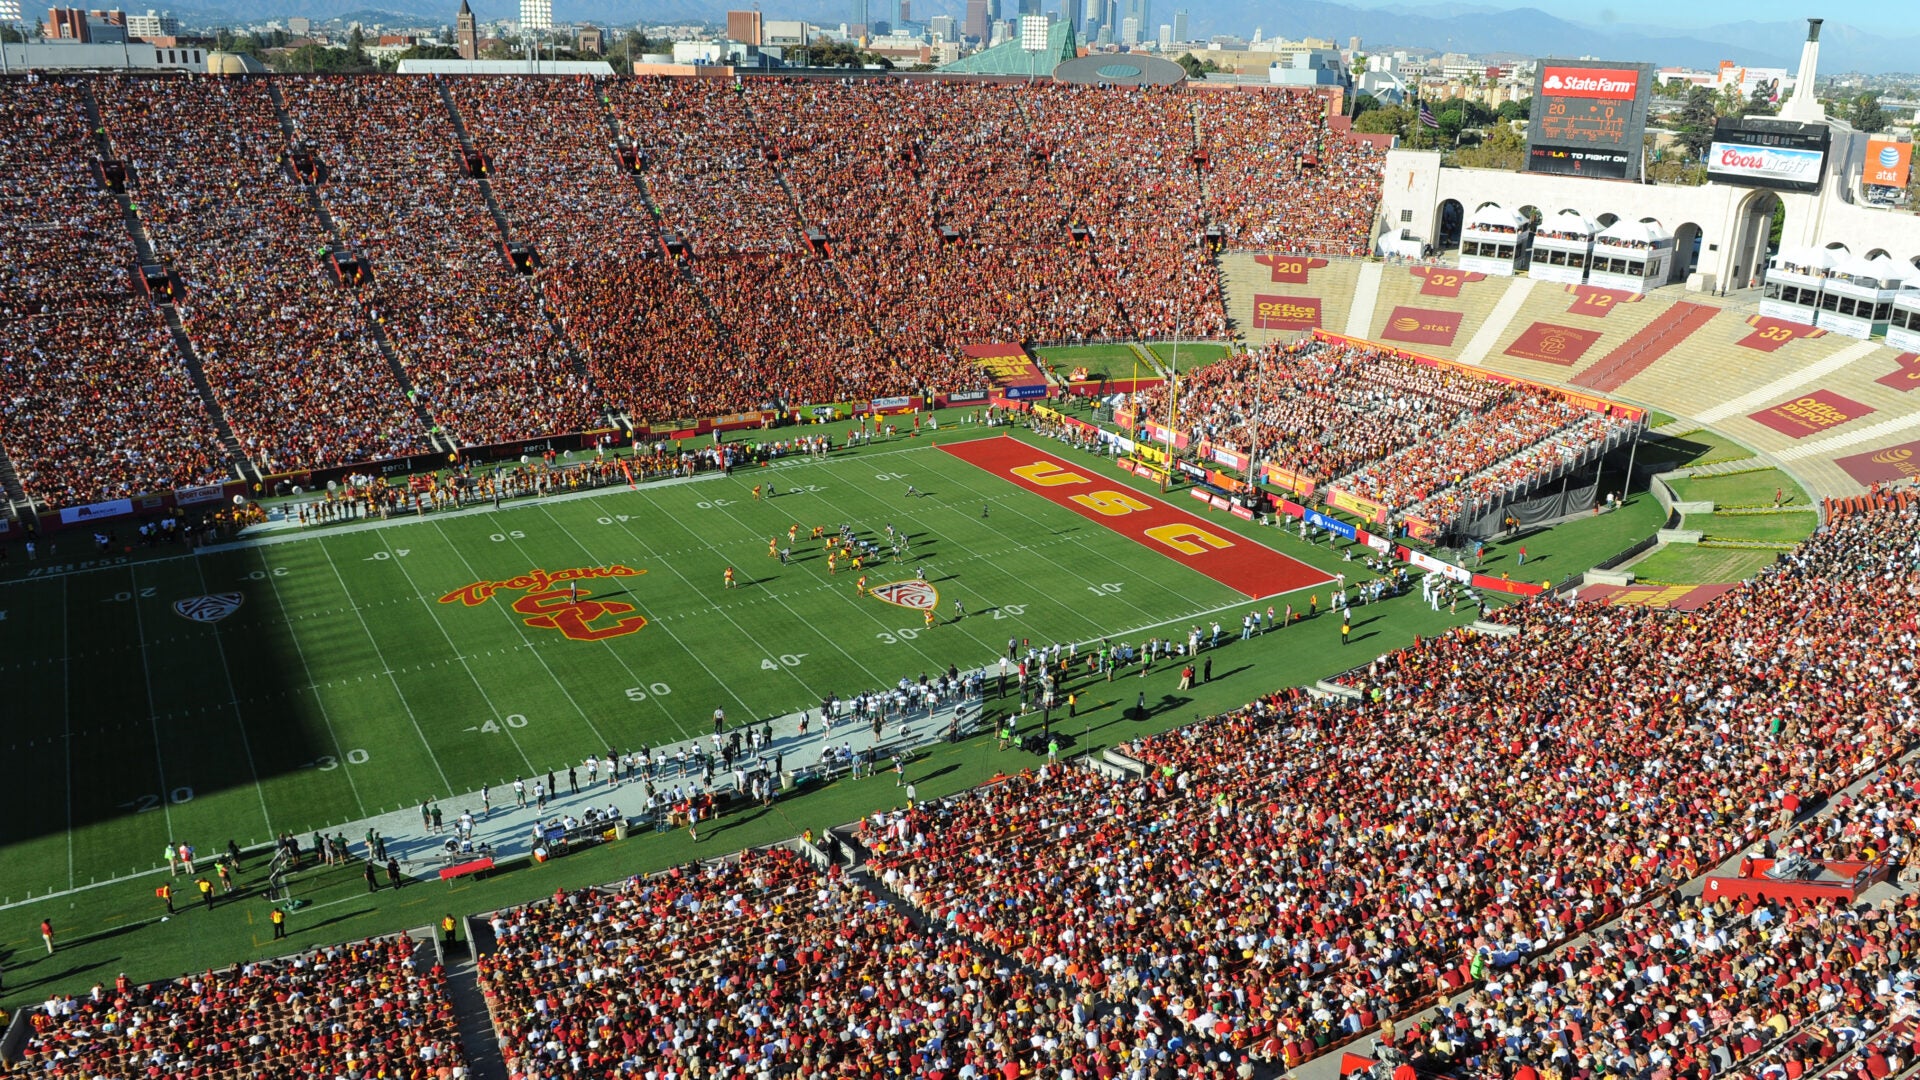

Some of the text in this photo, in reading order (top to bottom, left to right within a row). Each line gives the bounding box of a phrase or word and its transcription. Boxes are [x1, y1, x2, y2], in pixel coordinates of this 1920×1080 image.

[1548, 104, 1565, 115] 20
[1605, 107, 1614, 118] 0
[1585, 154, 1612, 162] FIGHT
[1720, 149, 1763, 169] Coors
[1875, 170, 1897, 182] at&t
[1278, 262, 1302, 274] 20
[1430, 274, 1458, 287] 32
[1584, 293, 1613, 307] 12
[1258, 302, 1316, 314] Office
[1258, 310, 1316, 319] DEPOT
[1422, 323, 1452, 333] at&t
[1759, 326, 1793, 341] 33
[1781, 404, 1837, 426] DEPOT
[1796, 398, 1848, 421] Office
[523, 444, 545, 453] zero
[382, 464, 405, 473] zero
[1324, 521, 1349, 534] FARMERS
[438, 565, 648, 607] Trojans
[1088, 582, 1119, 597] 10
[986, 604, 1024, 620] 20
[876, 628, 918, 645] 30
[760, 654, 801, 671] 40
[624, 682, 672, 702] 50
[480, 713, 530, 734] 40
[316, 747, 371, 772] 30
[135, 786, 196, 813] 20
[1710, 879, 1719, 890] 6
